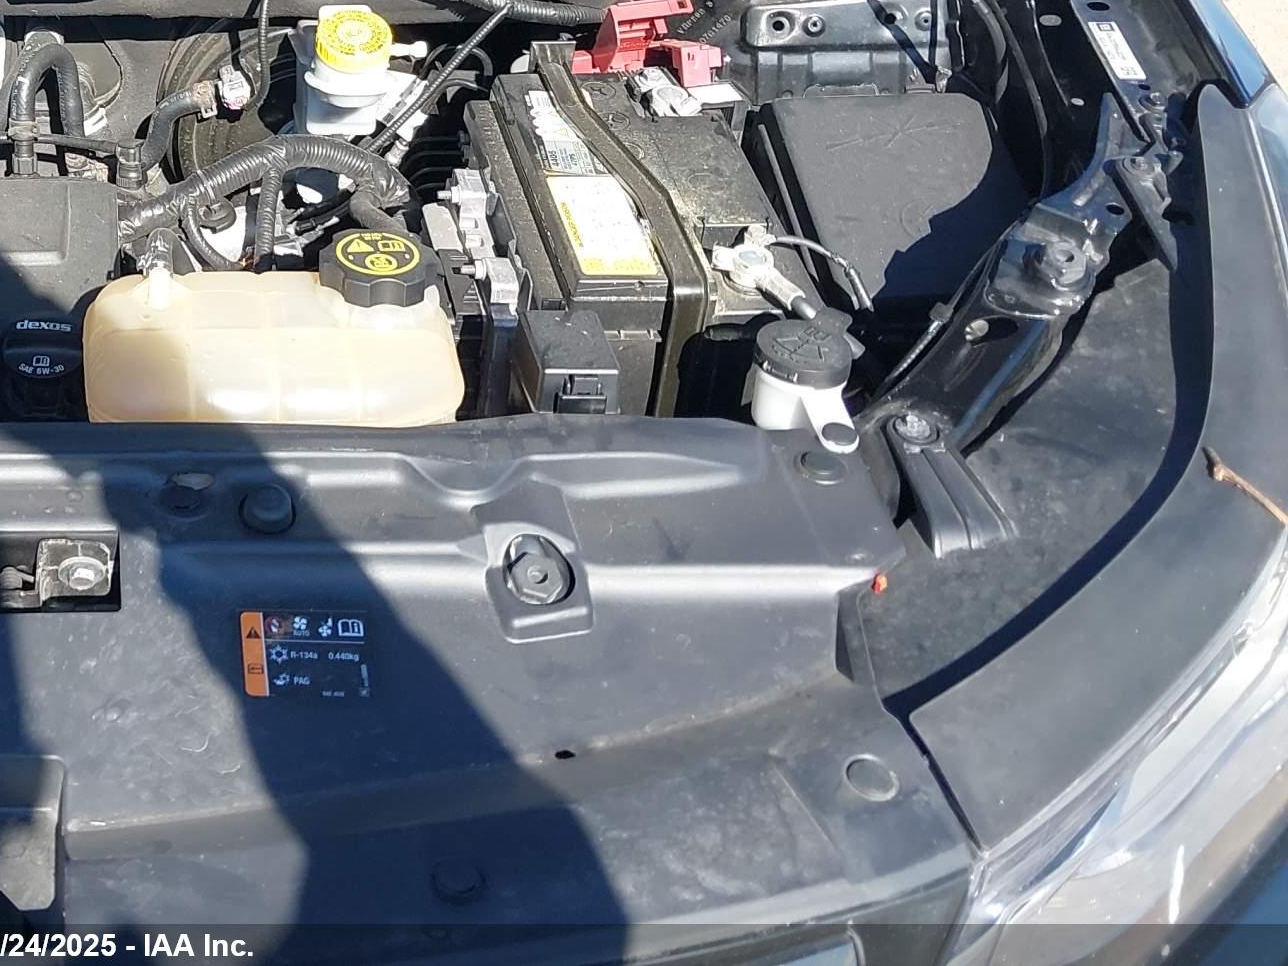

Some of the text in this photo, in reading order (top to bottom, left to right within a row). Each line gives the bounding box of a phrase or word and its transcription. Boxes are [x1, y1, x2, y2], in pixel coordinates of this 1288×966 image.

[16, 319, 73, 332] dexos
[18, 363, 34, 374] SAE
[290, 651, 318, 660] R-134a
[293, 676, 311, 686] PAG
